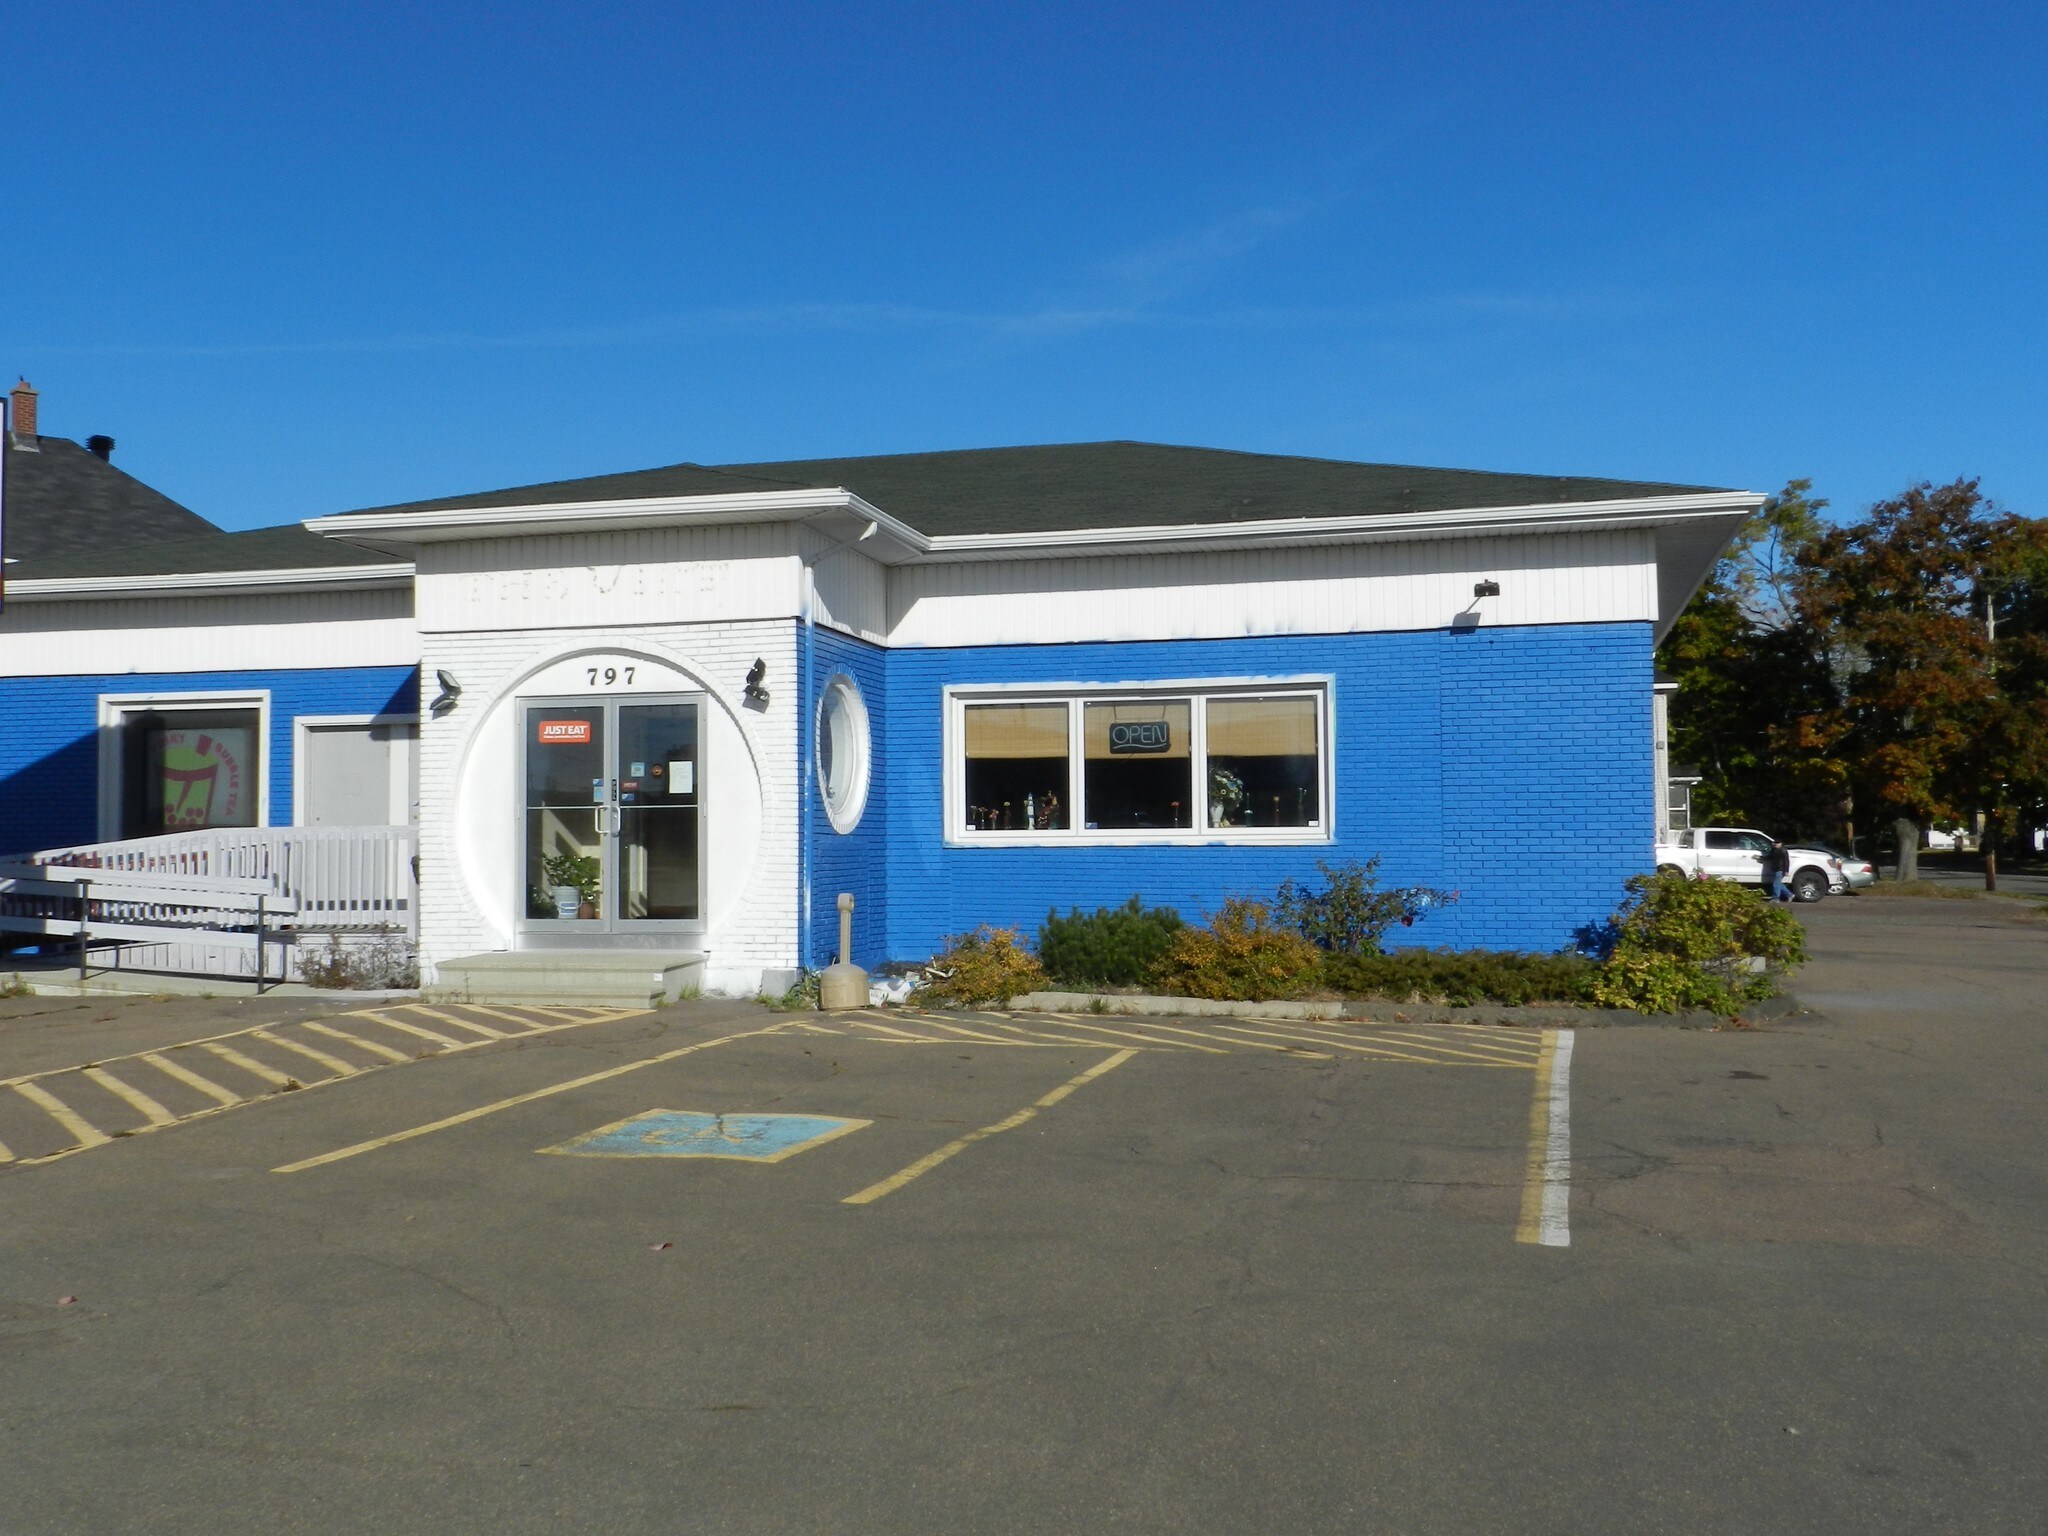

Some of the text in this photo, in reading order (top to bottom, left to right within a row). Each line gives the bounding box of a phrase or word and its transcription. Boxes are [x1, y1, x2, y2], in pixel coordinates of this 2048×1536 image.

[587, 666, 636, 686] 797
[543, 725, 586, 735] JUST EAT
[1112, 724, 1167, 744] OPEN
